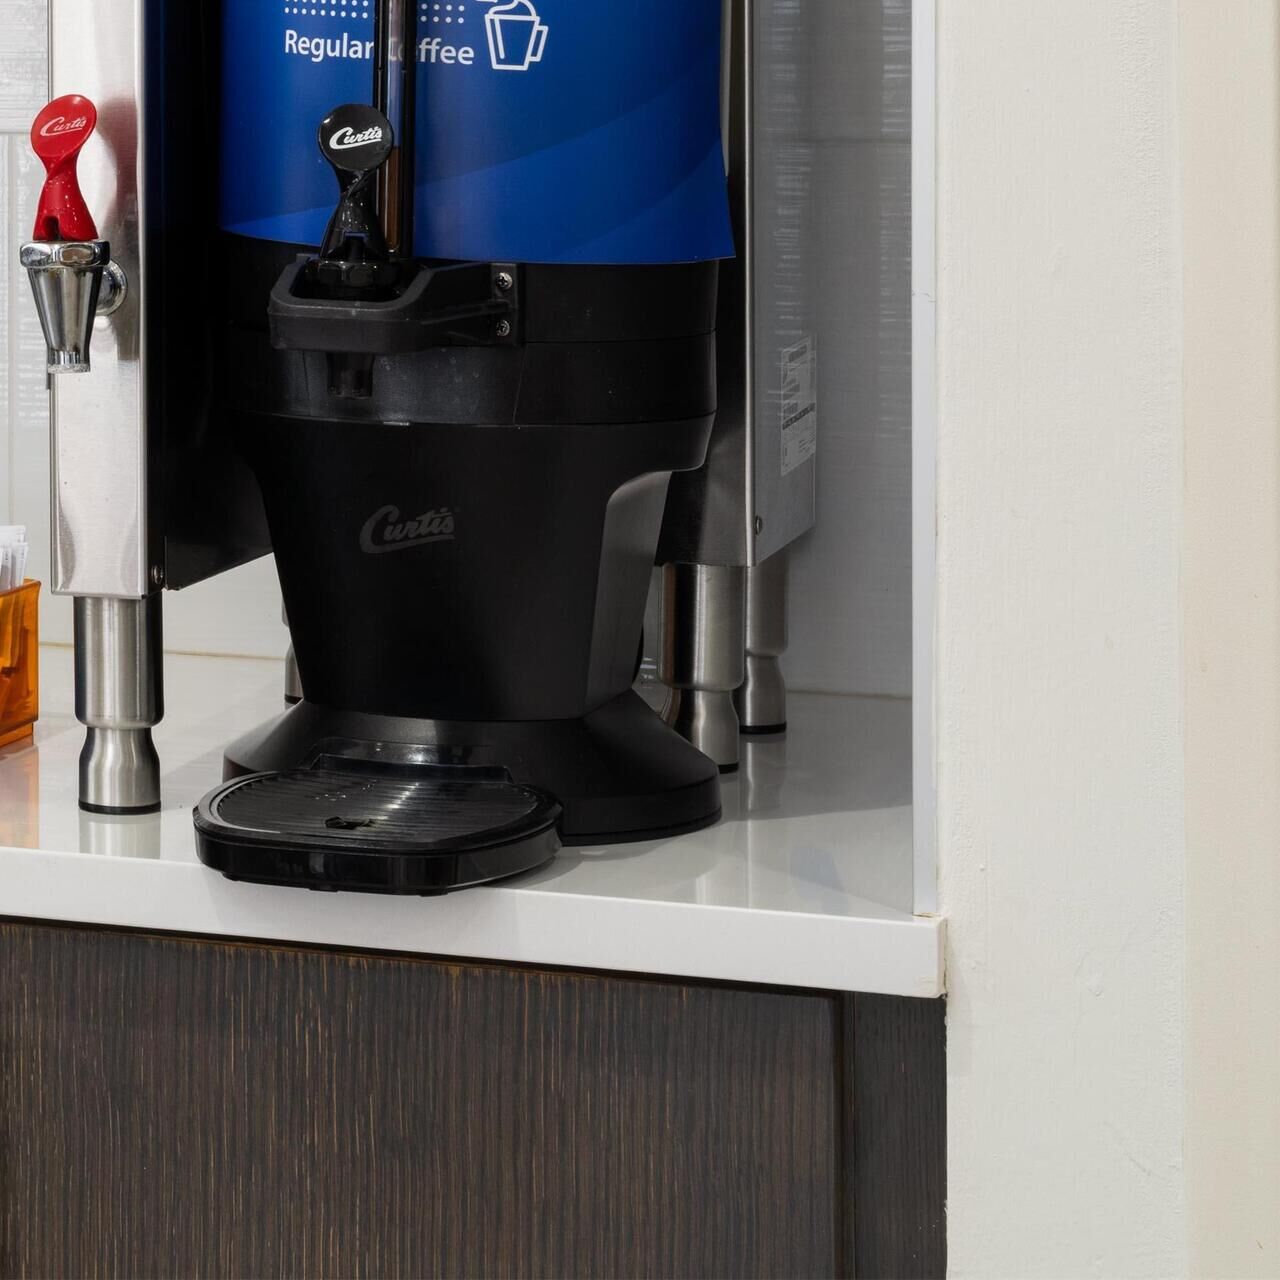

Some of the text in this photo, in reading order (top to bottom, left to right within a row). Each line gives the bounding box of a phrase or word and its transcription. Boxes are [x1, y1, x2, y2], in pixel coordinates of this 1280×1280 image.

[285, 30, 374, 62] Regular
[39, 116, 87, 137] Curtis
[329, 126, 382, 150] Curtis
[359, 504, 455, 553] Curtis
